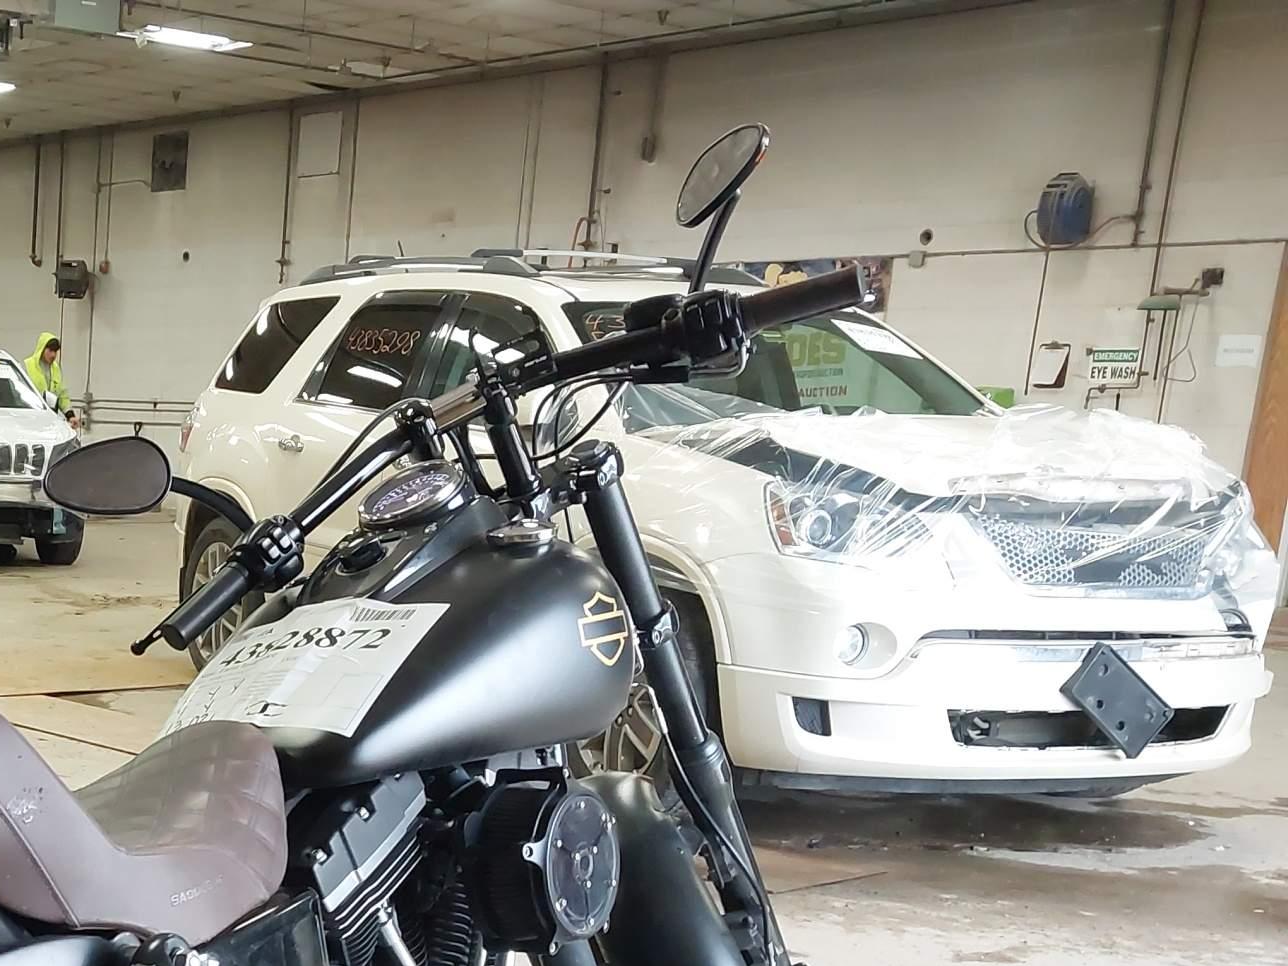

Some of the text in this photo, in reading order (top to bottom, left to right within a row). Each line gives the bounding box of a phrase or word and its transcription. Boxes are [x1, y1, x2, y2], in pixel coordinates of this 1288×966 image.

[1094, 352, 1138, 361] EMERGENCY
[1090, 366, 1136, 379] EYE WASH
[220, 626, 392, 667] 43828872
